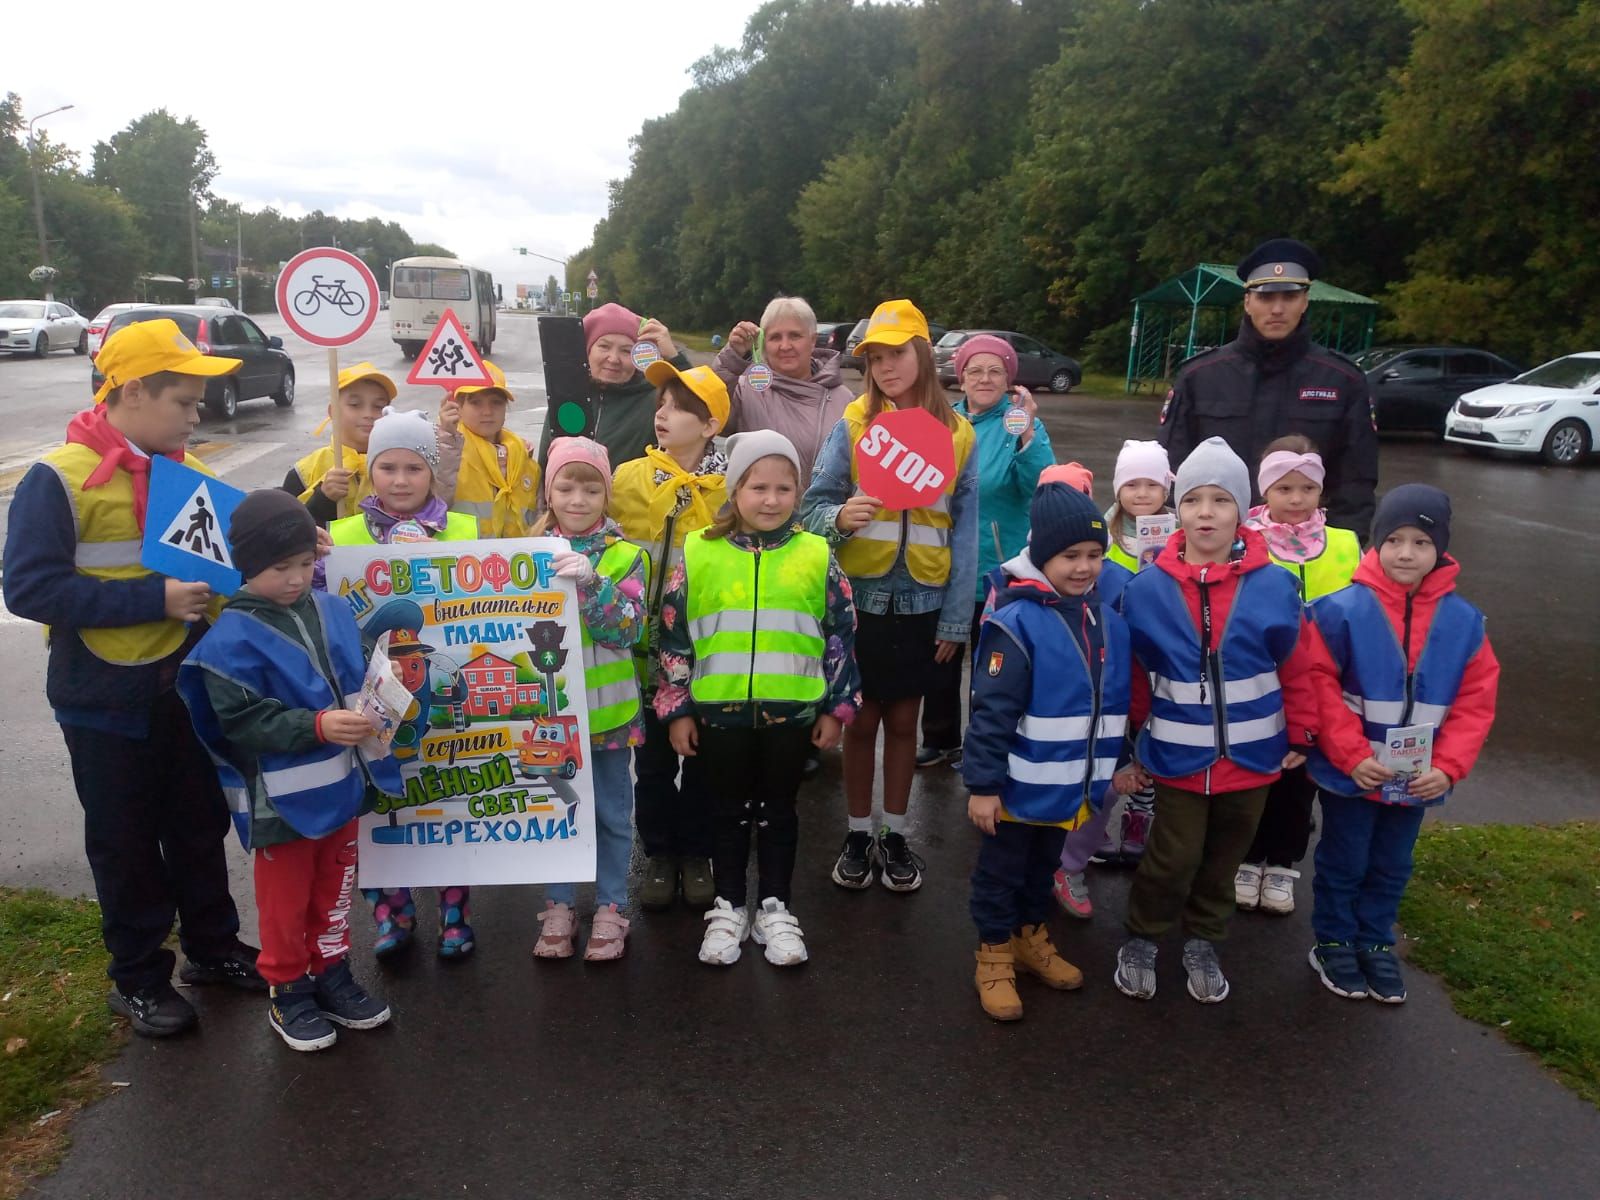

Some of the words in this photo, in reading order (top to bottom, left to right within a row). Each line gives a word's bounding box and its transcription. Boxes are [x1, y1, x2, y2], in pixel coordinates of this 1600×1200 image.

[860, 424, 945, 493] STOP
[366, 552, 557, 596] СВЕТОФОР
[434, 598, 560, 623] внимательно
[443, 622, 524, 647] ГЛЯДИ:
[426, 732, 508, 766] горит
[404, 802, 578, 846] ПЕРЕХОДИ!
